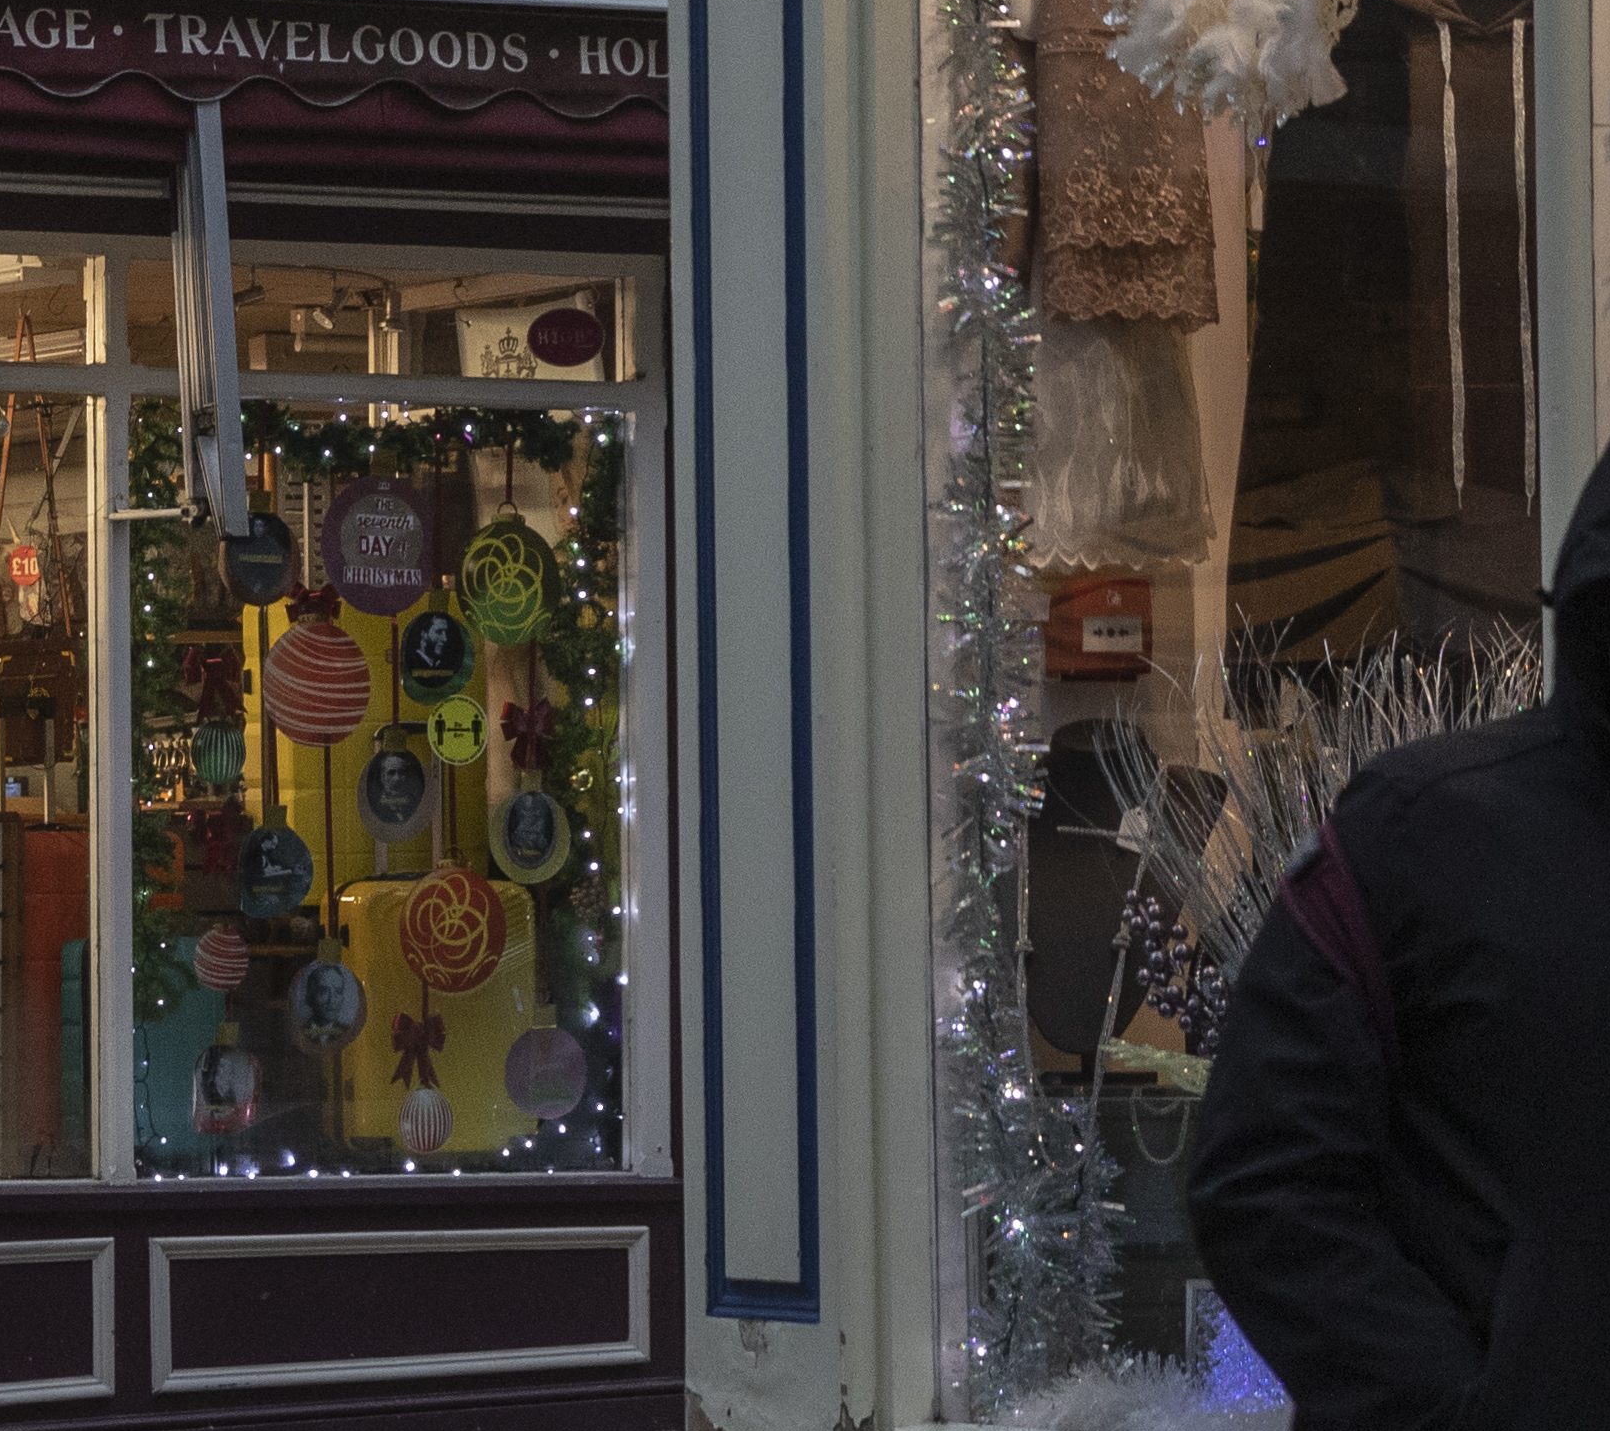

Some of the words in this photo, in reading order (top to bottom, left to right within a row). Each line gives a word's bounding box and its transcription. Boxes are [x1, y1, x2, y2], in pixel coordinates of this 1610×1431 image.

[144, 13, 529, 74] TRAVELGOODS
[579, 35, 668, 78] HOL
[359, 535, 394, 557] DAY
[12, 556, 40, 576] £10
[343, 567, 423, 586] CHRISTMAS
